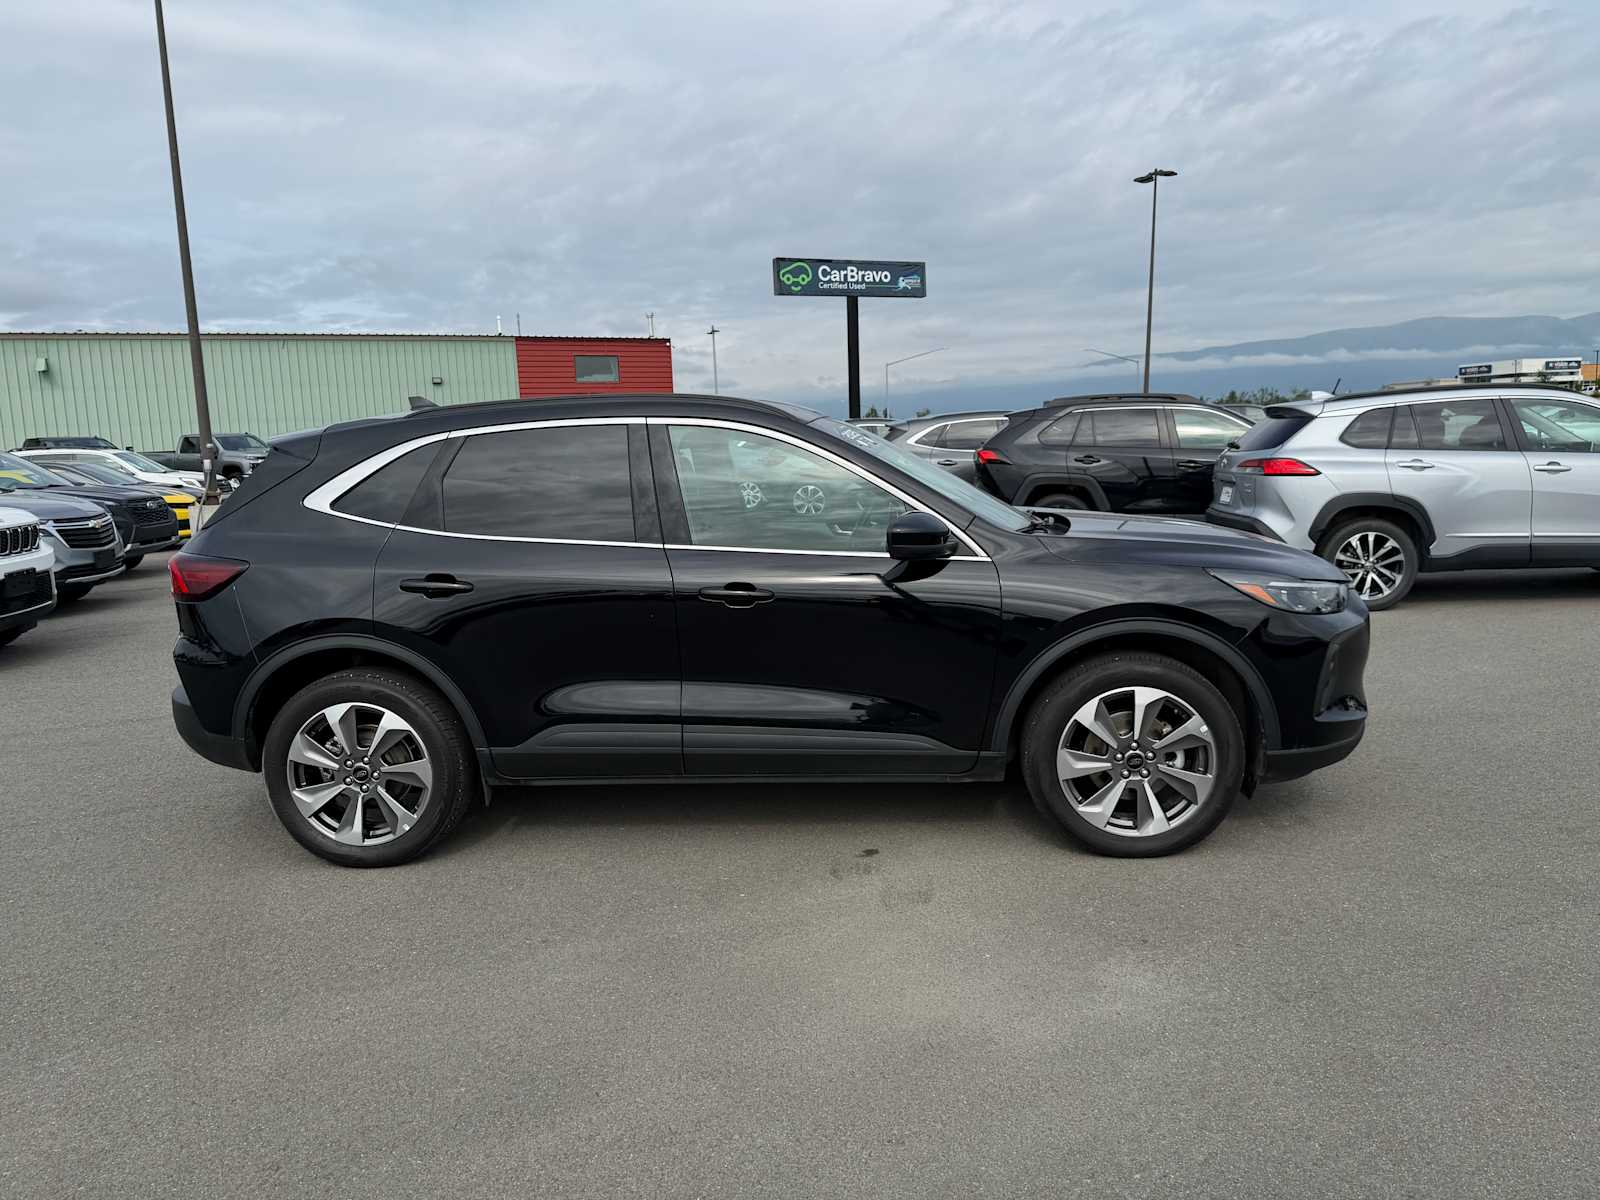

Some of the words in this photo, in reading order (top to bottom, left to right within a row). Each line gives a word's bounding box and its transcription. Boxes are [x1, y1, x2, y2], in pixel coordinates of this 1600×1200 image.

[818, 265, 891, 283] CarBravo
[818, 281, 848, 290] Certified
[849, 282, 866, 290] Used
